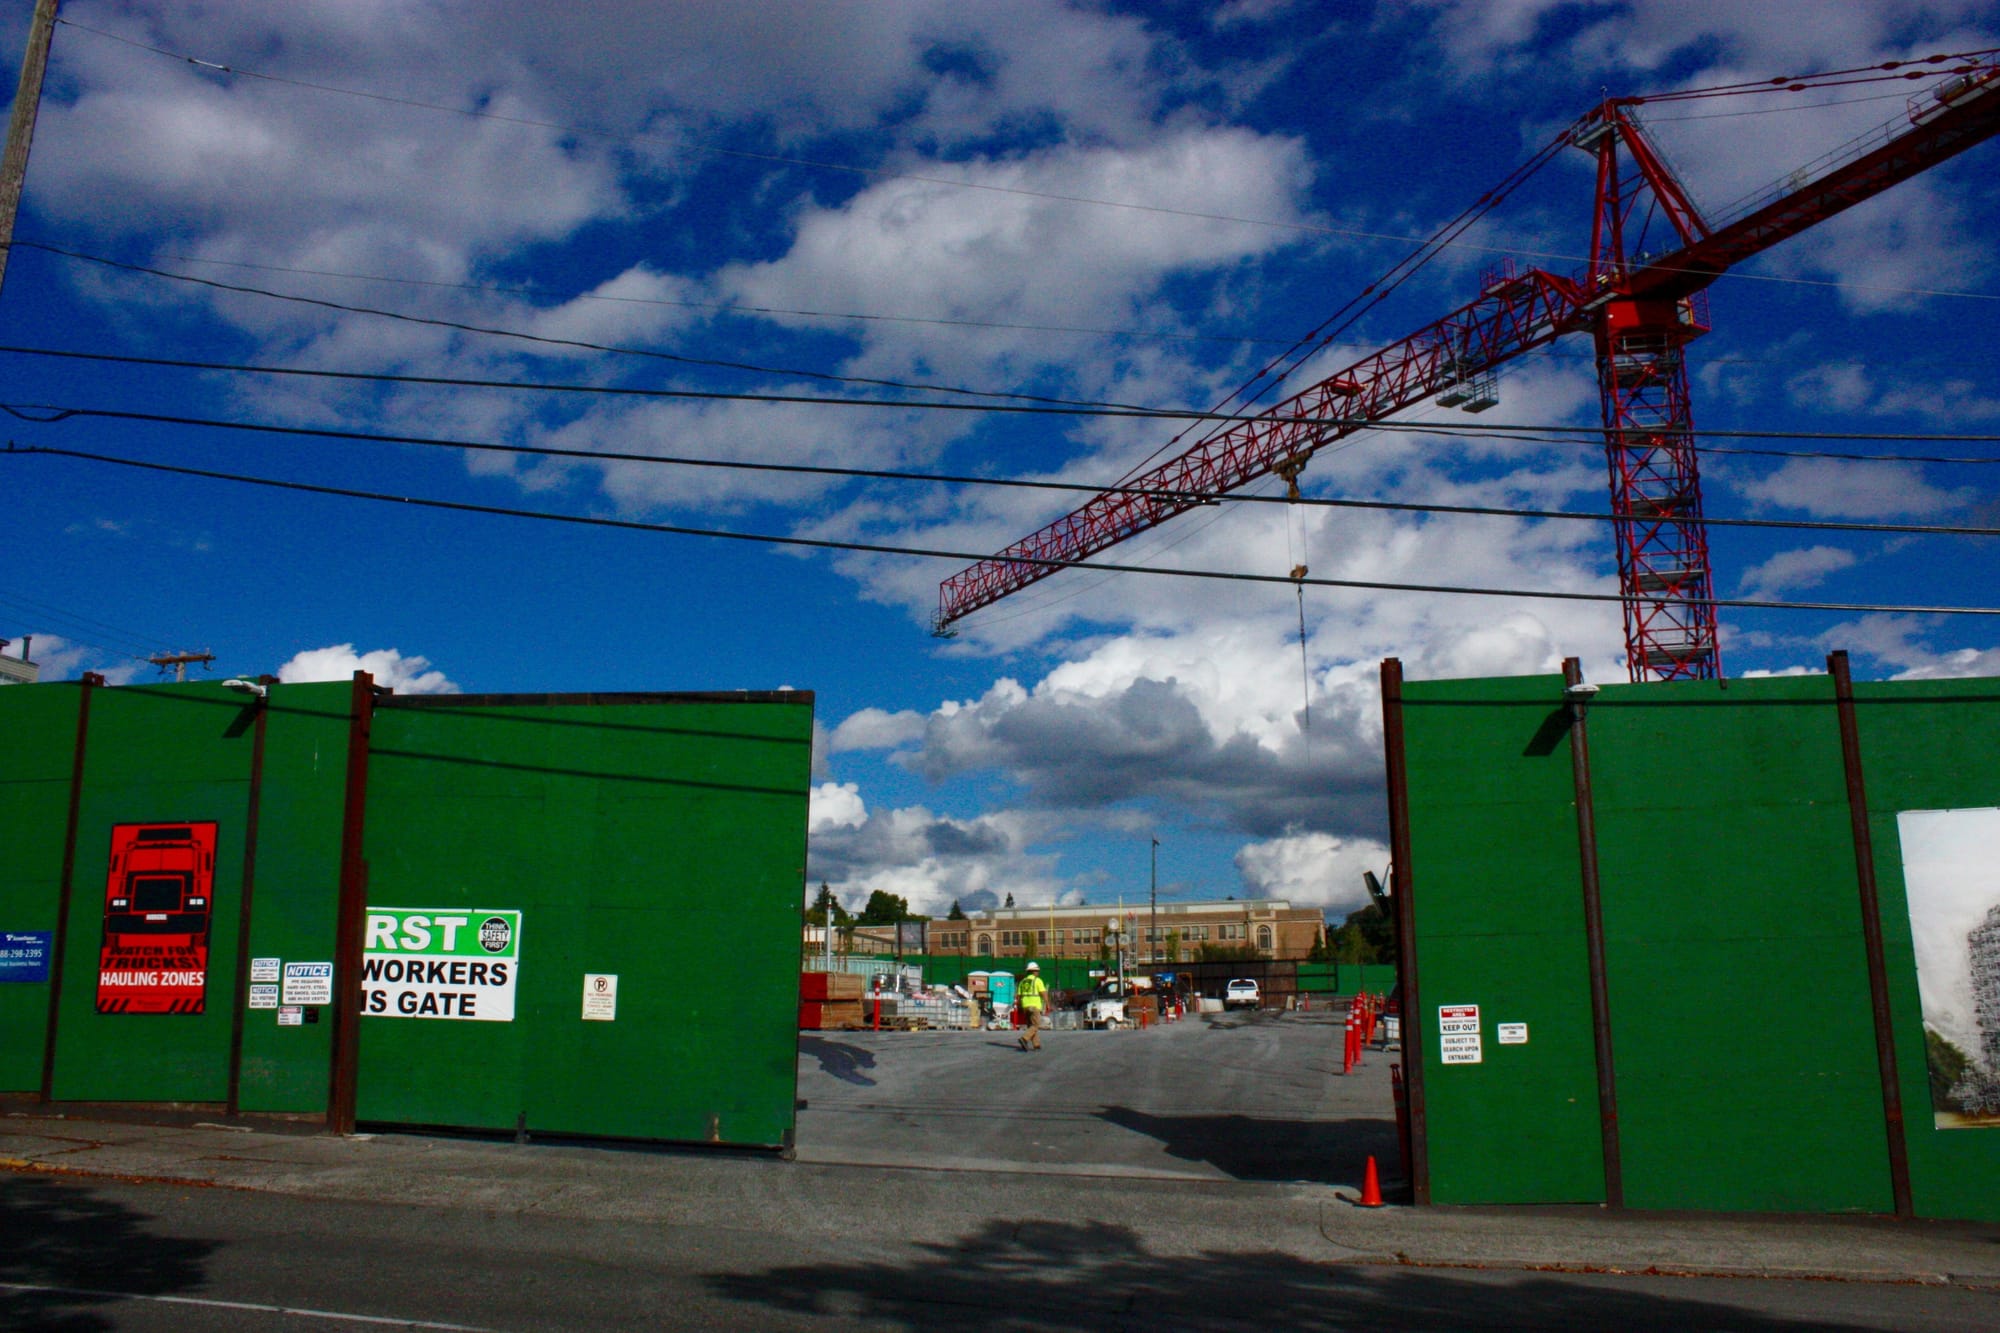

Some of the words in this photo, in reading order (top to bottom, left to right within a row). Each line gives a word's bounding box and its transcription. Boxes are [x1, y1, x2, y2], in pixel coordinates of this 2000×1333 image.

[485, 922, 506, 930] THINK
[366, 914, 468, 951] RST
[482, 930, 509, 941] SAFETY
[485, 941, 505, 949] FIRST
[107, 946, 163, 957] WATCH
[167, 946, 198, 956] FOR
[103, 957, 202, 969] TRUCKS!
[288, 966, 329, 976] NOTICE
[362, 959, 508, 986] WORKERS
[100, 971, 158, 986] HAULING
[160, 971, 205, 986] ZONES
[361, 989, 387, 1013] IS
[397, 991, 476, 1016] GATE
[1462, 1023, 1476, 1031] OUT
